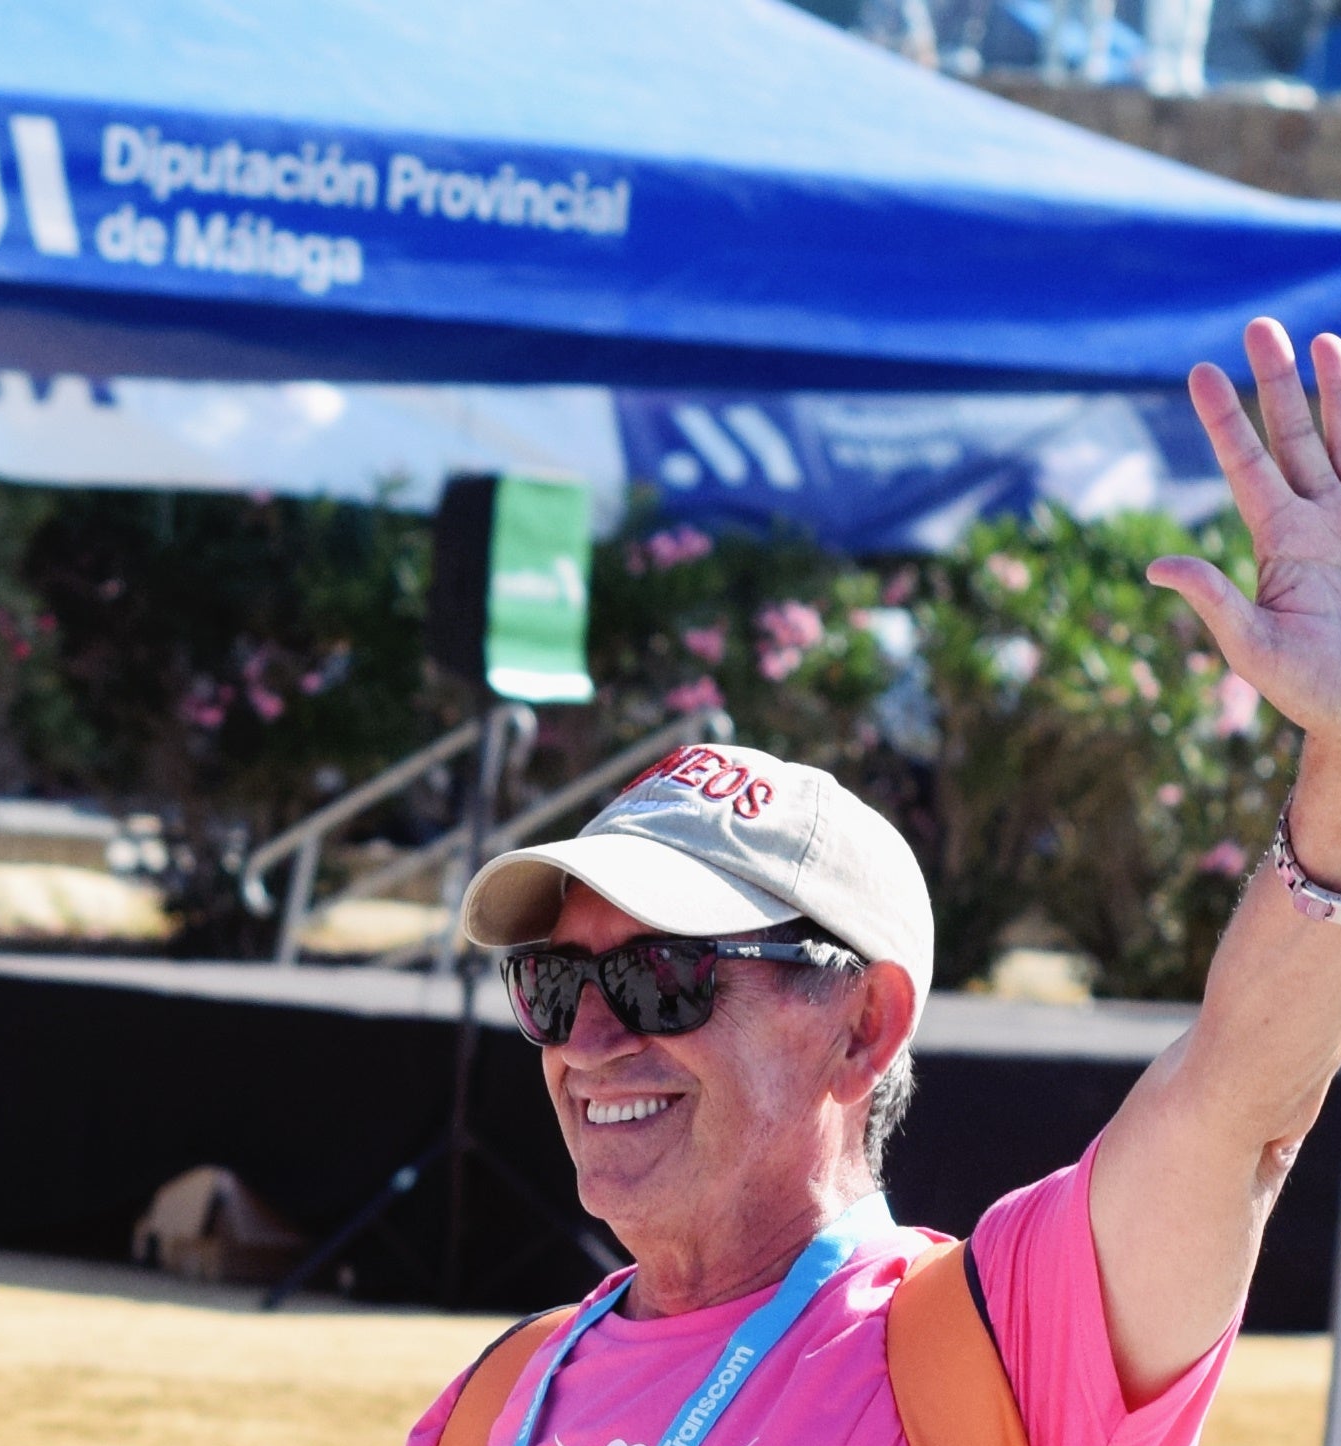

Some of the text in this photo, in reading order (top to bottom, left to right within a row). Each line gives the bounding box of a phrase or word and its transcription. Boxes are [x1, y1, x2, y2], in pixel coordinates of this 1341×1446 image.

[101, 122, 632, 235] Diputación Provincial
[96, 203, 364, 294] de Málaga
